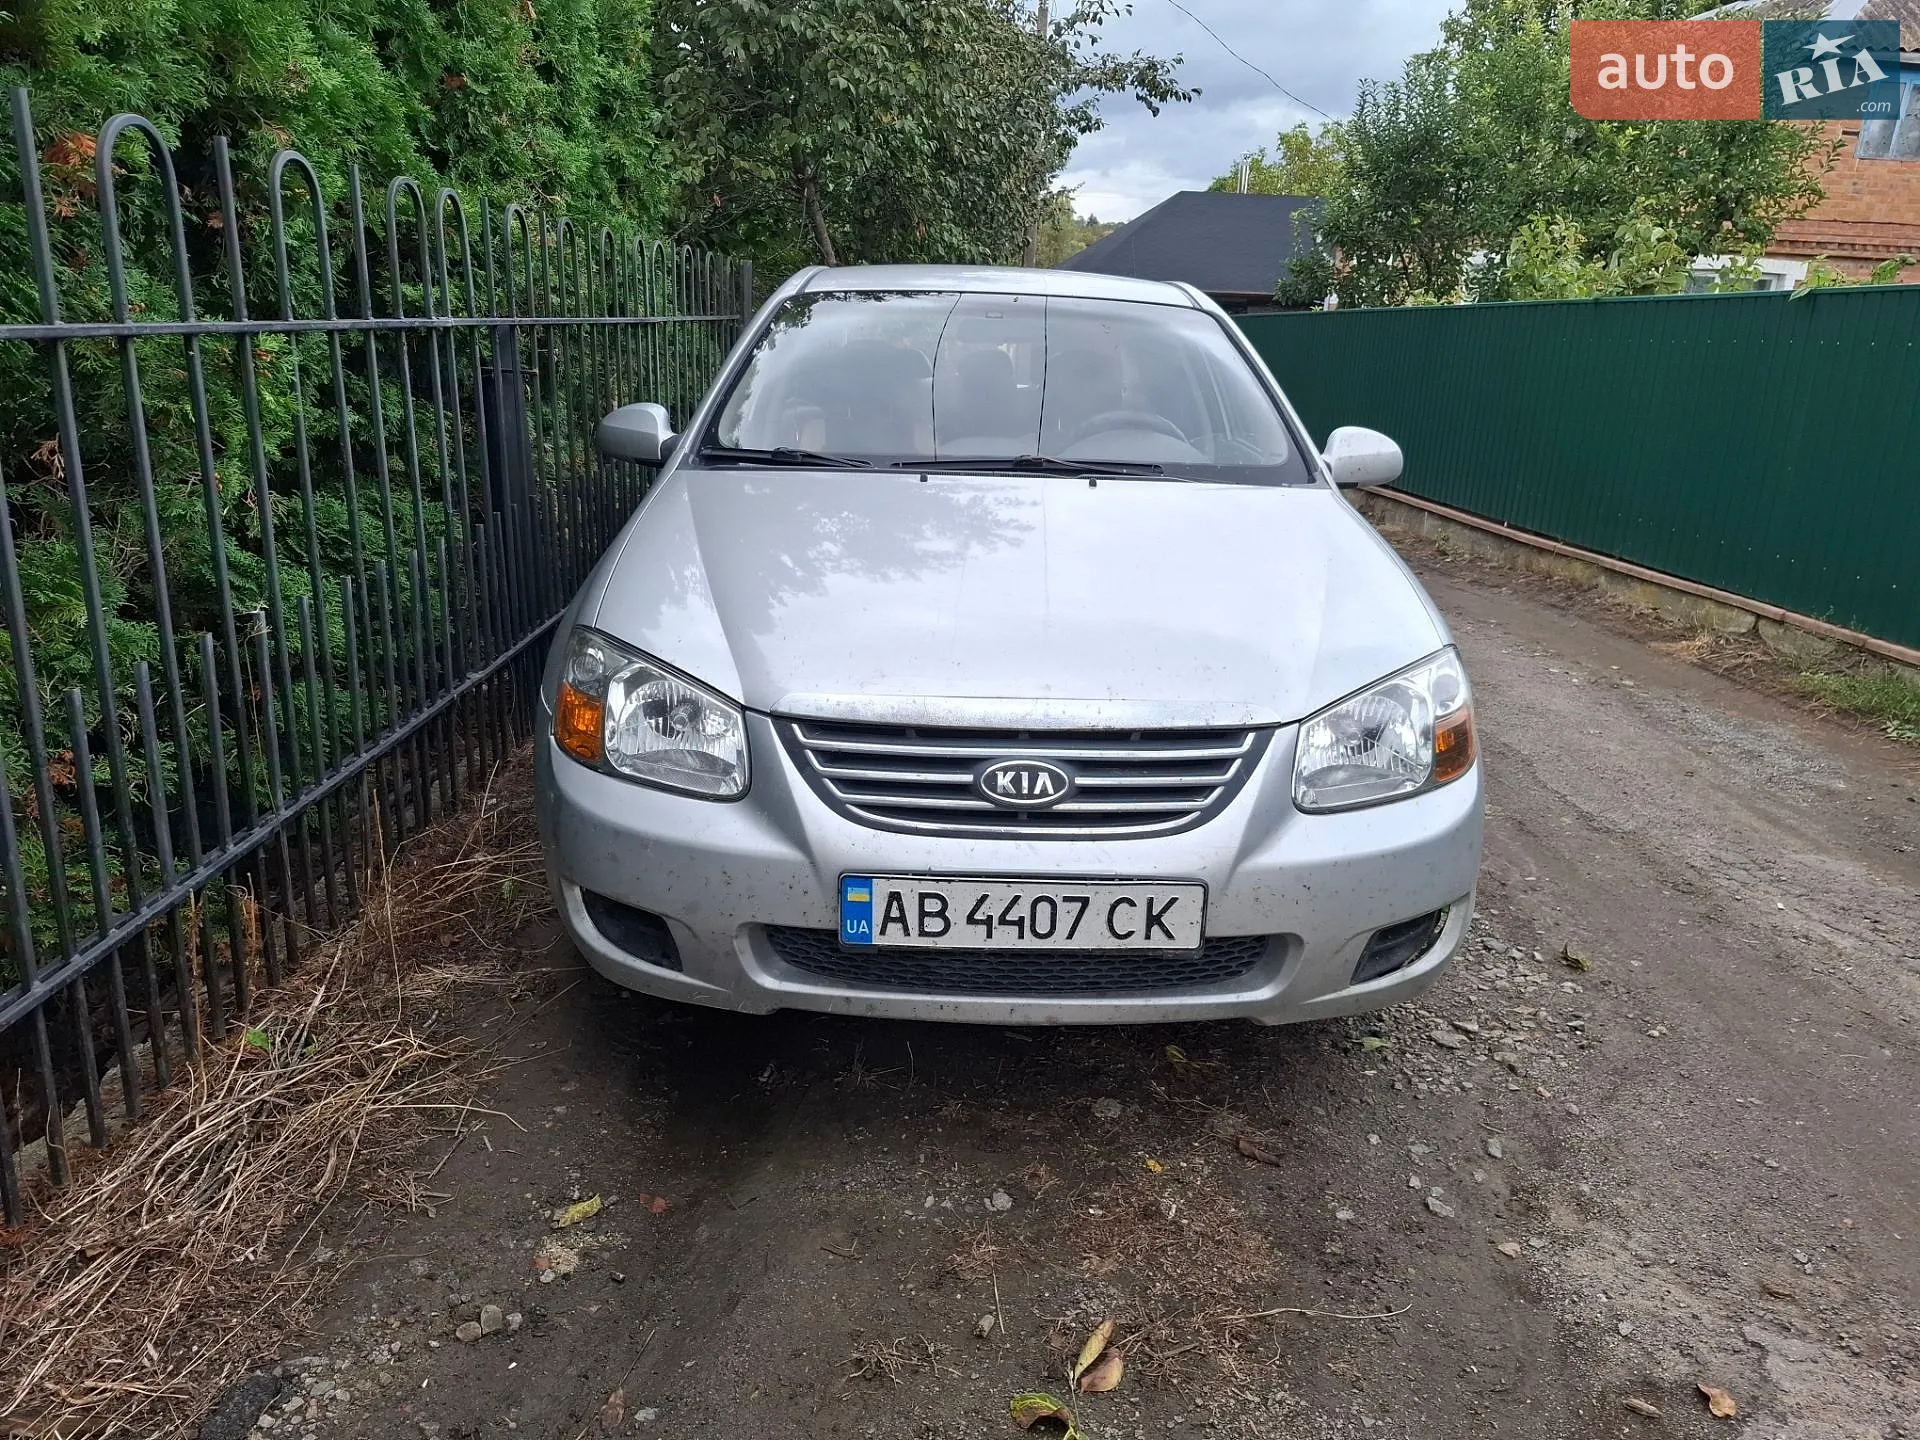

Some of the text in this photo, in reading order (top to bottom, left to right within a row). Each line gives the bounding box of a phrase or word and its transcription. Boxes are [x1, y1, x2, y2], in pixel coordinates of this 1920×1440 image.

[995, 771, 1055, 795] KIA
[846, 919, 869, 935] UA
[879, 890, 1180, 941] AB 4407 CK
